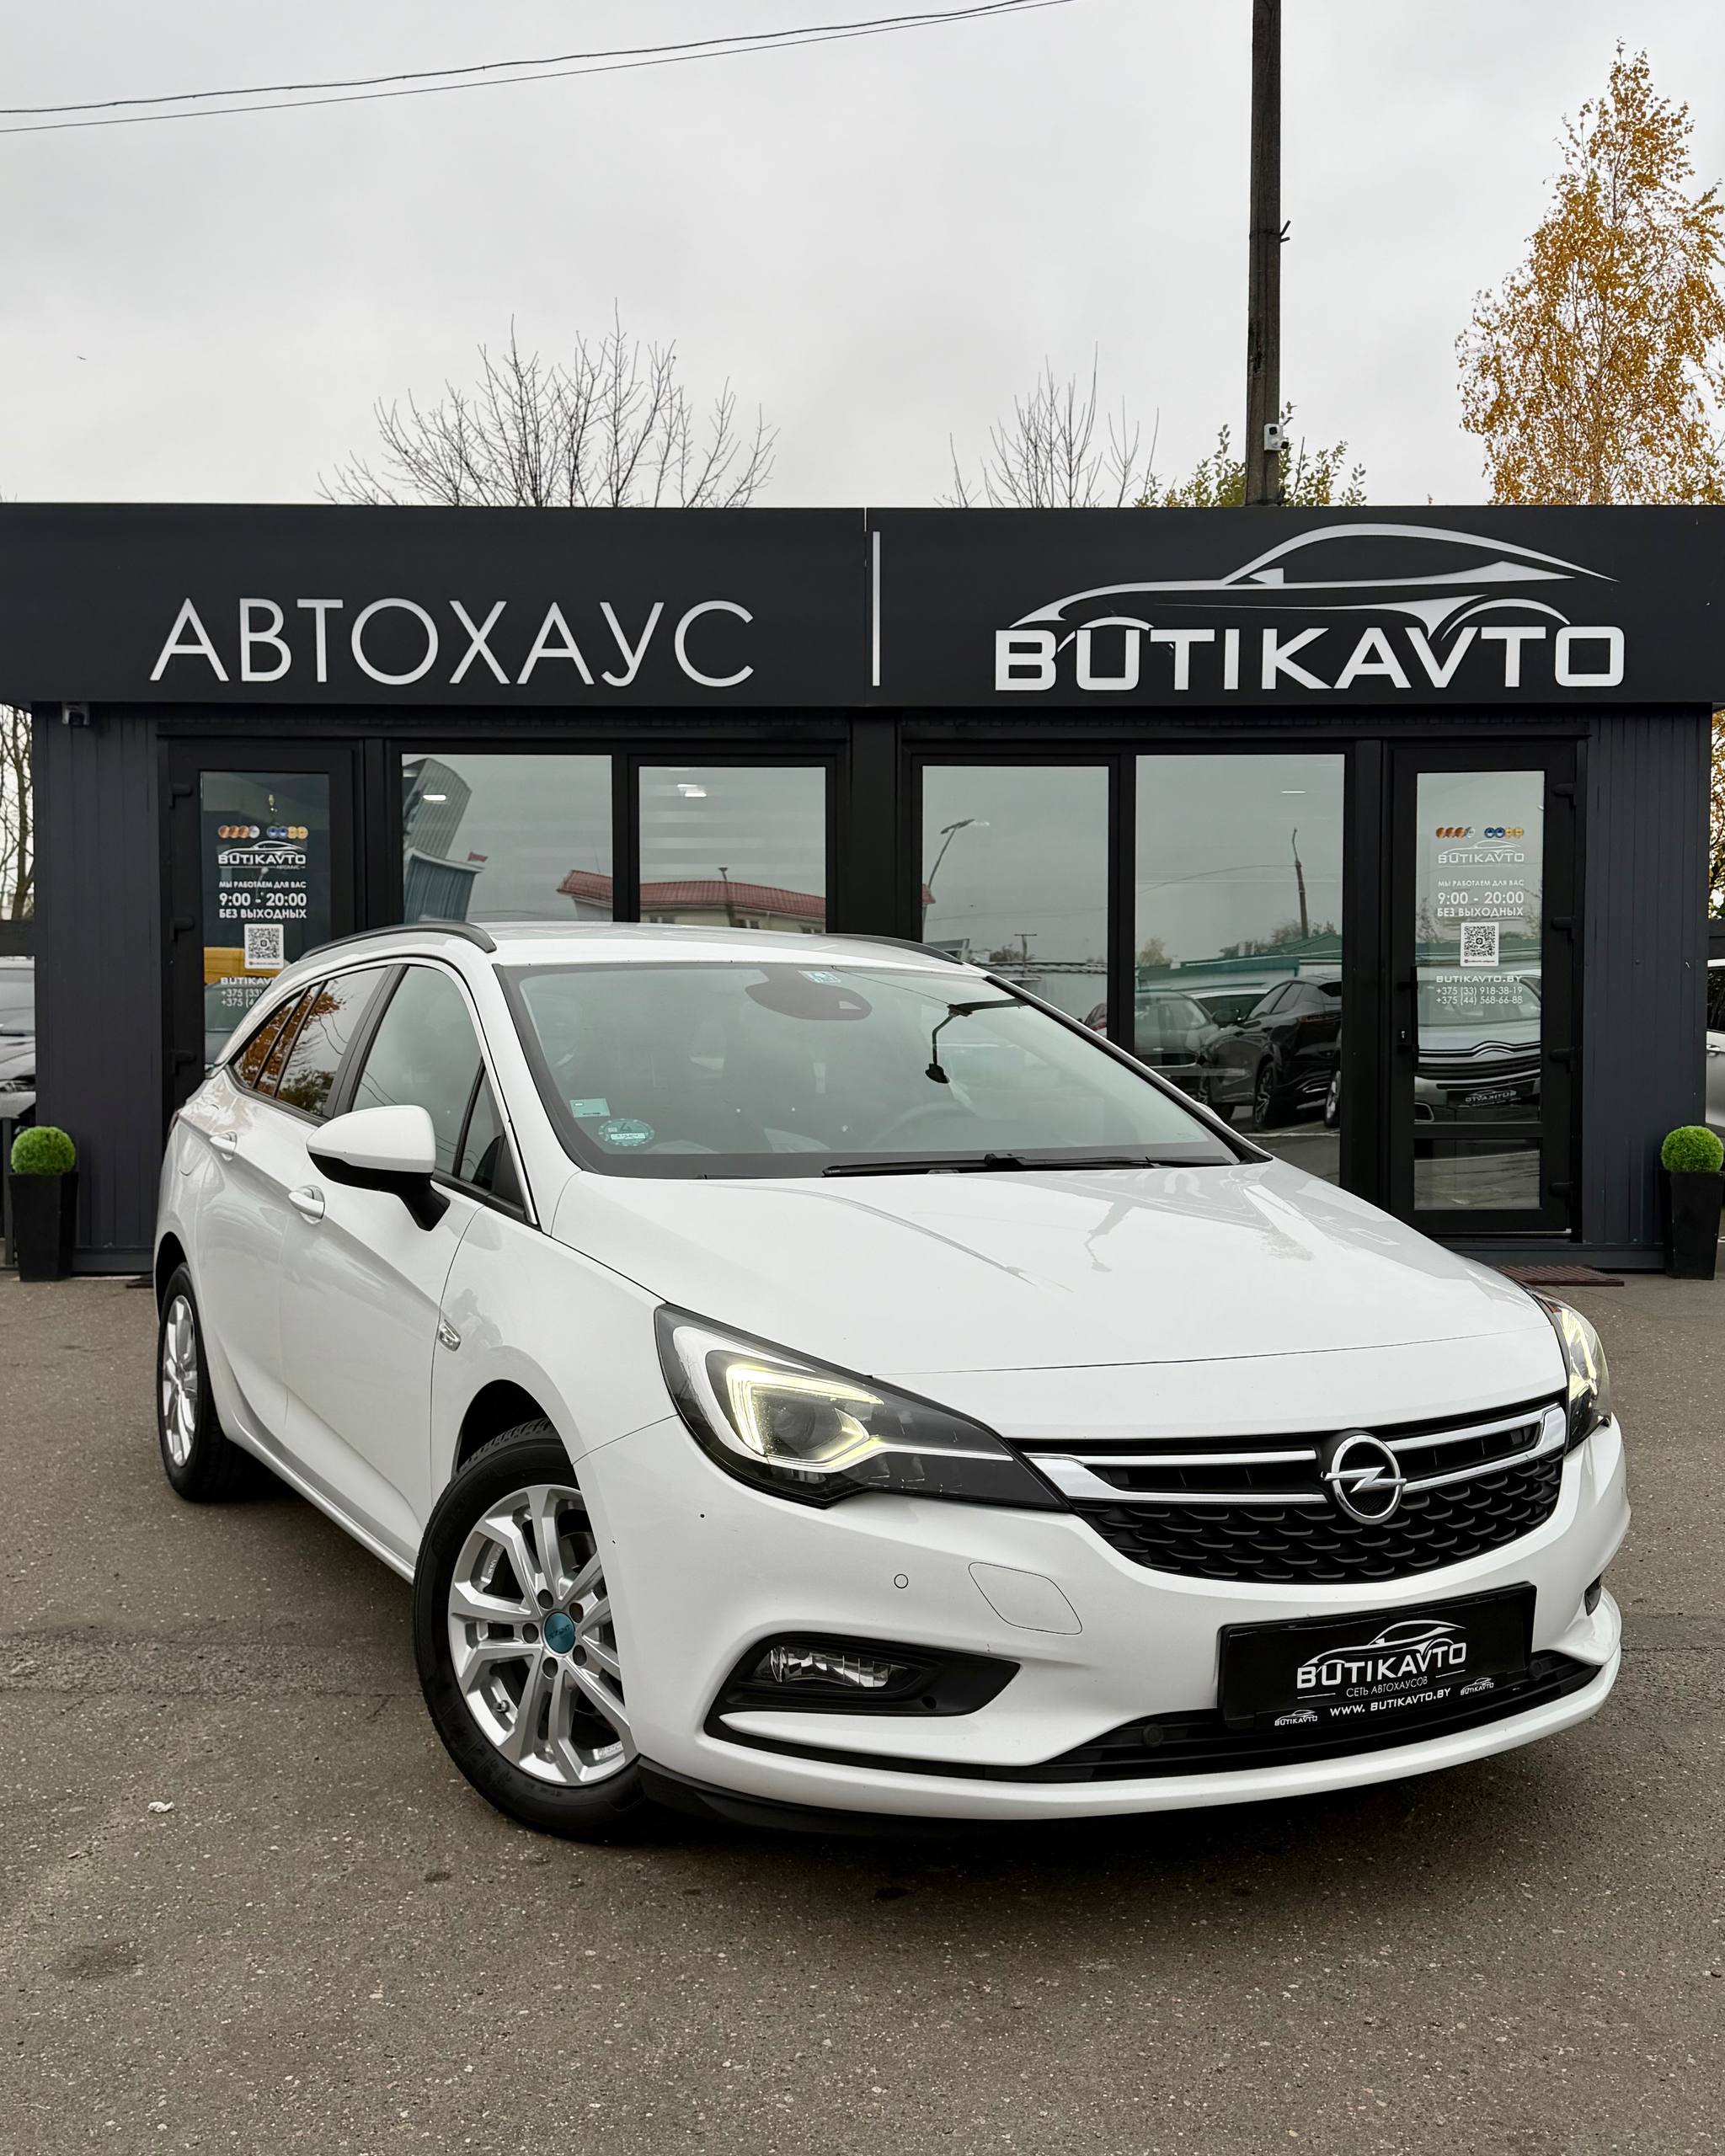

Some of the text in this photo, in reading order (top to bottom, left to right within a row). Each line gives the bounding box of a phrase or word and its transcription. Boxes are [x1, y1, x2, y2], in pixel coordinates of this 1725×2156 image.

[150, 597, 755, 687] АВТОХАУС
[995, 626, 1625, 691] BUTIKAVTO
[218, 854, 307, 865] BUTIKAVTO
[1438, 852, 1525, 863] BUTIKAVTO
[274, 881, 290, 889] ДЛЯ
[219, 893, 251, 906] 9:00
[266, 893, 307, 906] 20:00
[1438, 892, 1468, 905] 9:00
[1484, 892, 1524, 904] 20:00
[219, 909, 307, 920] БЕЗ ВЫХОДНЫХ
[1437, 907, 1523, 917] БЕЗ ВЫХОДНЫХ
[222, 989, 243, 997] +375
[1461, 986, 1477, 996] (33)
[1479, 986, 1523, 995] 918-38-19
[222, 998, 243, 1007] +375
[1436, 996, 1458, 1005] +375
[1461, 995, 1477, 1006] (44)
[1296, 1642, 1467, 1689] BUTIKAVTO
[1346, 1676, 1429, 1698] СЕТЬ АВТОХАУСОВ
[1460, 1682, 1495, 1695] BUTIKAVTO
[1330, 1688, 1451, 1716] WWW. BUTIKAVTO.BY
[1274, 1715, 1318, 1726] BUTIKAVTO
